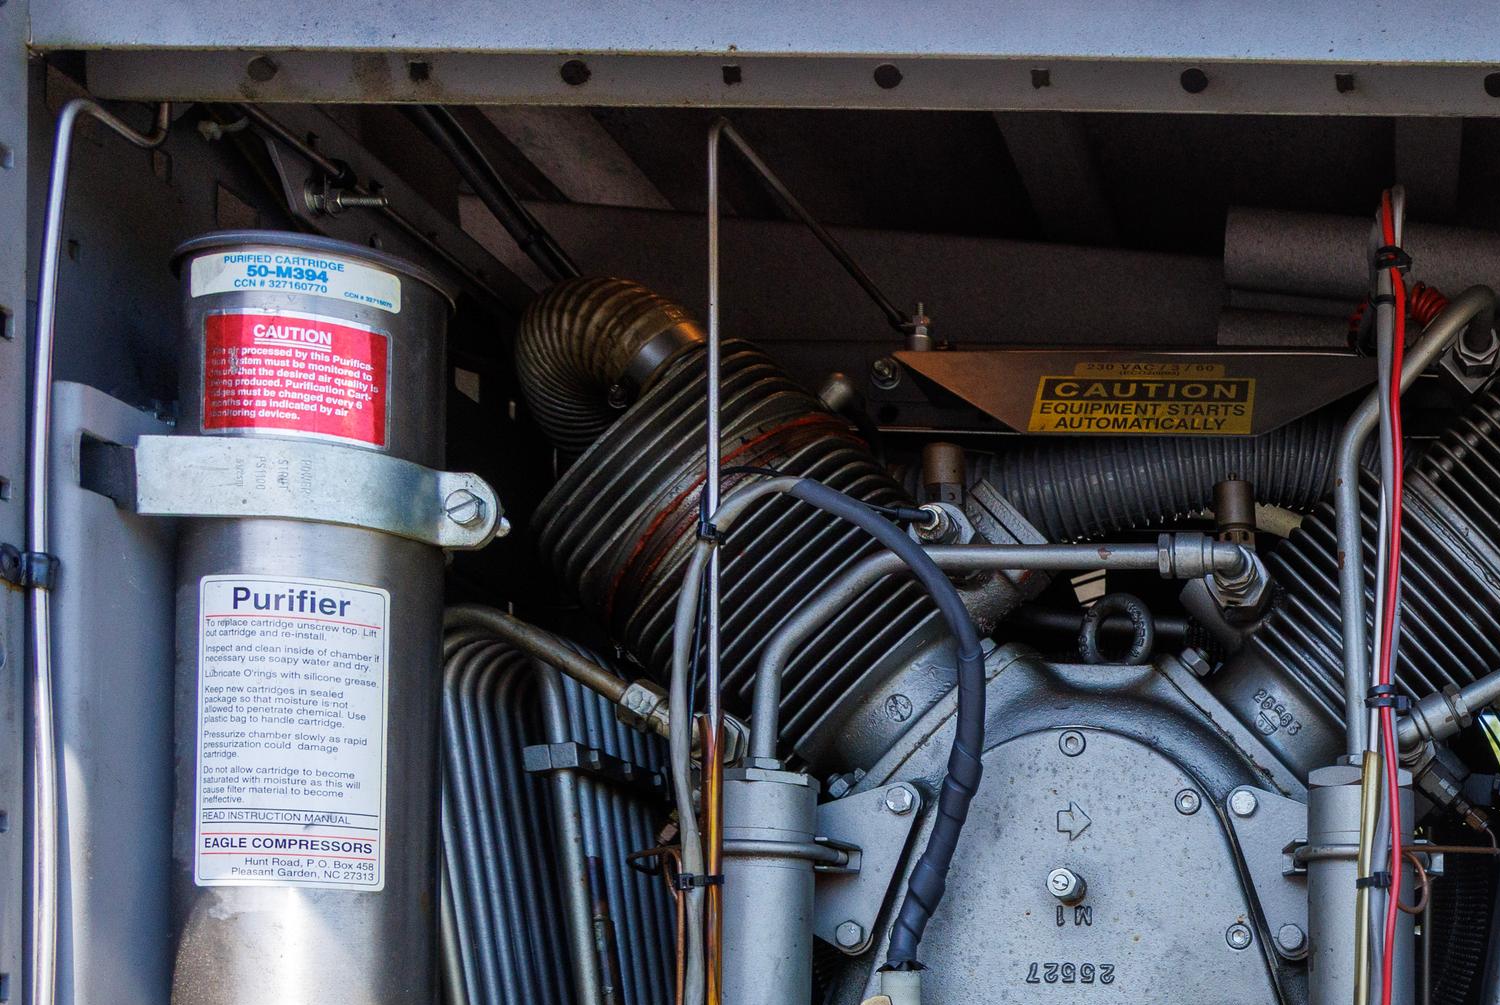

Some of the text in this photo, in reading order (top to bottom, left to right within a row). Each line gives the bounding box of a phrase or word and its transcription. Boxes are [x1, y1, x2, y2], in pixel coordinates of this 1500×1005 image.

[224, 254, 345, 272] PURIFIED CARTRIDGE
[246, 265, 328, 283] 50-M394
[234, 279, 256, 288] CCN
[268, 280, 327, 293] 327160770
[253, 324, 332, 345] CAUTION
[241, 346, 292, 356] processed
[295, 350, 307, 360] by
[310, 352, 330, 362] this
[333, 355, 374, 371] Purifica-
[264, 358, 372, 381] must be monitored to
[259, 368, 378, 393] the desired air quality is
[235, 378, 372, 401] produced. Purification Cart-
[1054, 382, 1237, 399] CAUTION
[279, 390, 362, 409] changed every 6
[258, 409, 300, 419] devices.
[1039, 402, 1246, 417] EQUIPMENT STARTS
[1054, 417, 1227, 431] AUTOMATICALLY
[233, 586, 351, 617] Purifier
[206, 618, 378, 638] To replace cartridge unscrew top. Lift
[205, 686, 224, 695] Keep
[247, 686, 295, 696] cartridges
[298, 687, 307, 695] in
[310, 688, 344, 699] sealed
[204, 714, 228, 725] plastic
[230, 714, 247, 725] bag
[261, 716, 295, 725] handle
[298, 716, 345, 729] cartridge.
[204, 730, 246, 739] Pressurize
[248, 731, 291, 740] chamber
[294, 732, 325, 744] slowly
[344, 736, 368, 746] rapid
[204, 741, 339, 754] pressurization could damage
[204, 766, 213, 774] Do
[216, 766, 228, 774] not
[230, 766, 252, 774] allow
[256, 766, 299, 776] cartridge
[316, 769, 355, 779] become
[202, 812, 350, 824] READ INSTRUCTION MANUAL
[204, 838, 372, 854] EAGLE COMPRESSORS
[244, 858, 373, 871] Hunt Road, P.O. Box 458
[232, 867, 374, 881] Pleasant Garden, NC 27313
[1026, 962, 1115, 984] 25527
